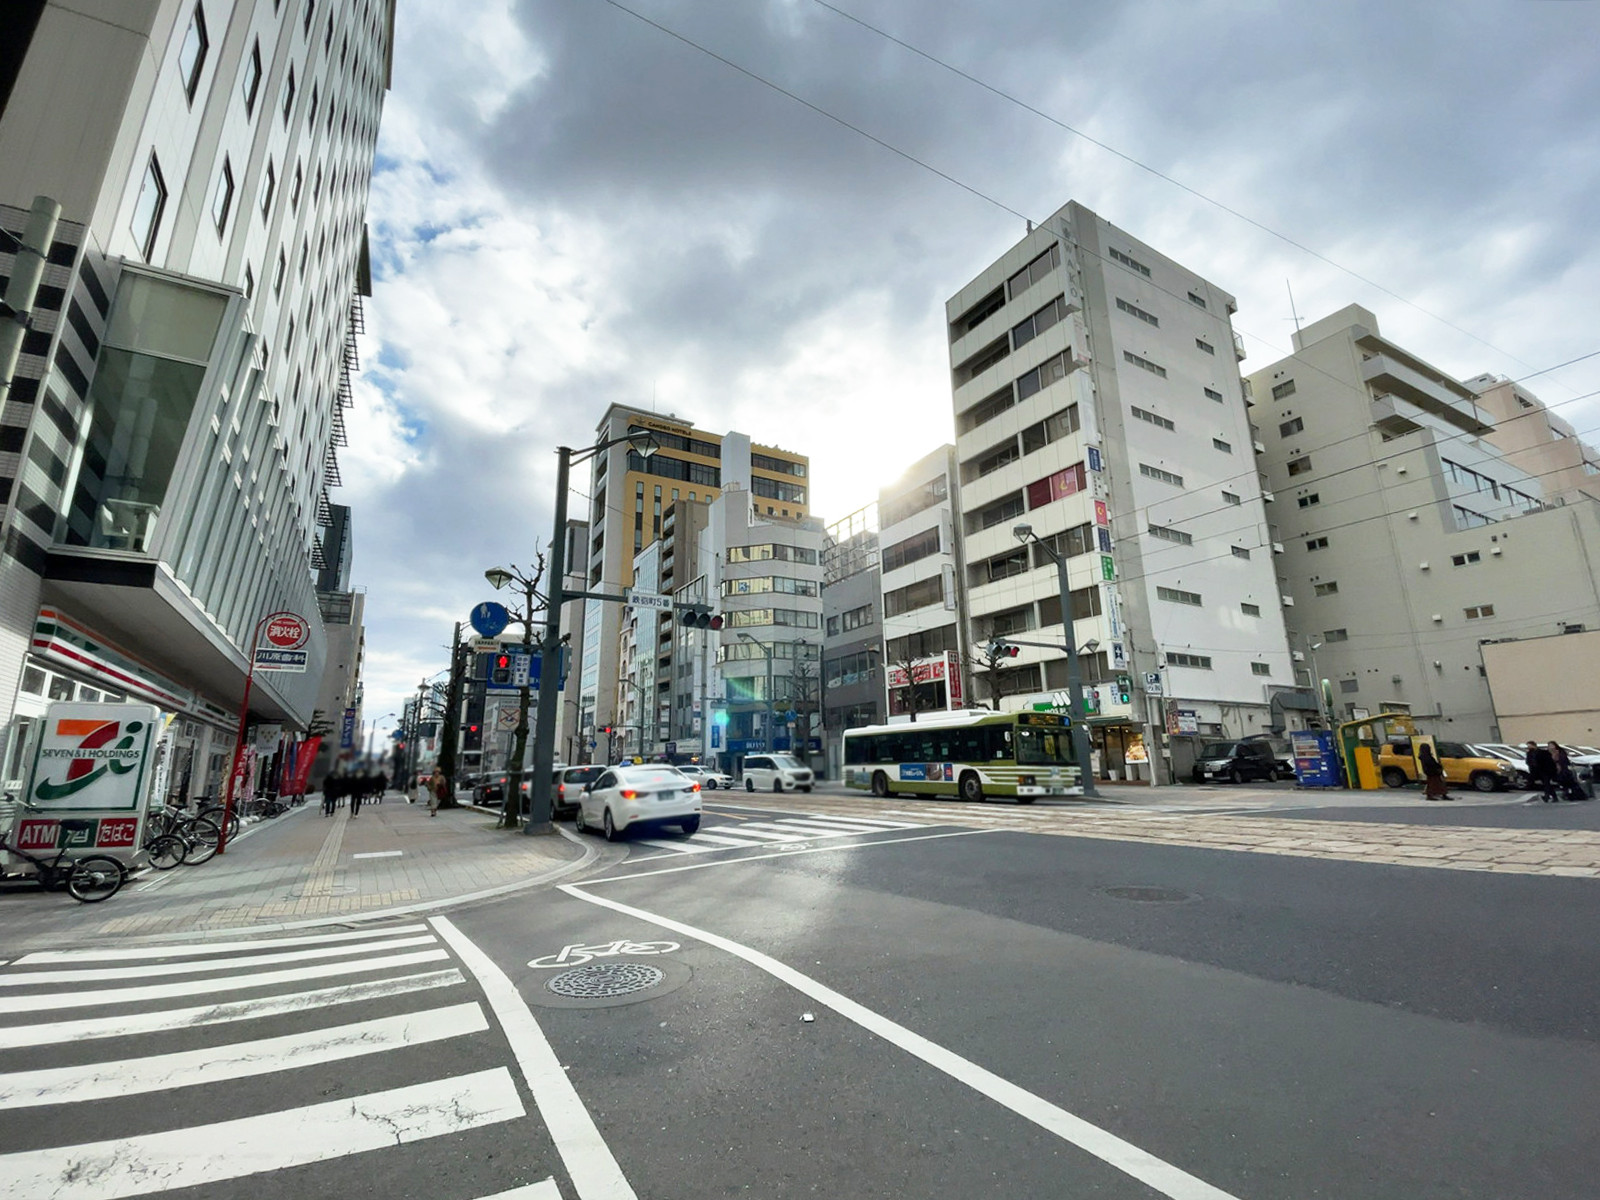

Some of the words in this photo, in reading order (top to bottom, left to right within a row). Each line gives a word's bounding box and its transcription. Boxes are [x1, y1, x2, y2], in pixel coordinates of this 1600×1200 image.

[269, 625, 300, 639] 消火栓
[89, 749, 140, 759] HOLDINGS
[20, 824, 57, 844] ATM
[99, 823, 135, 842] たばこ
